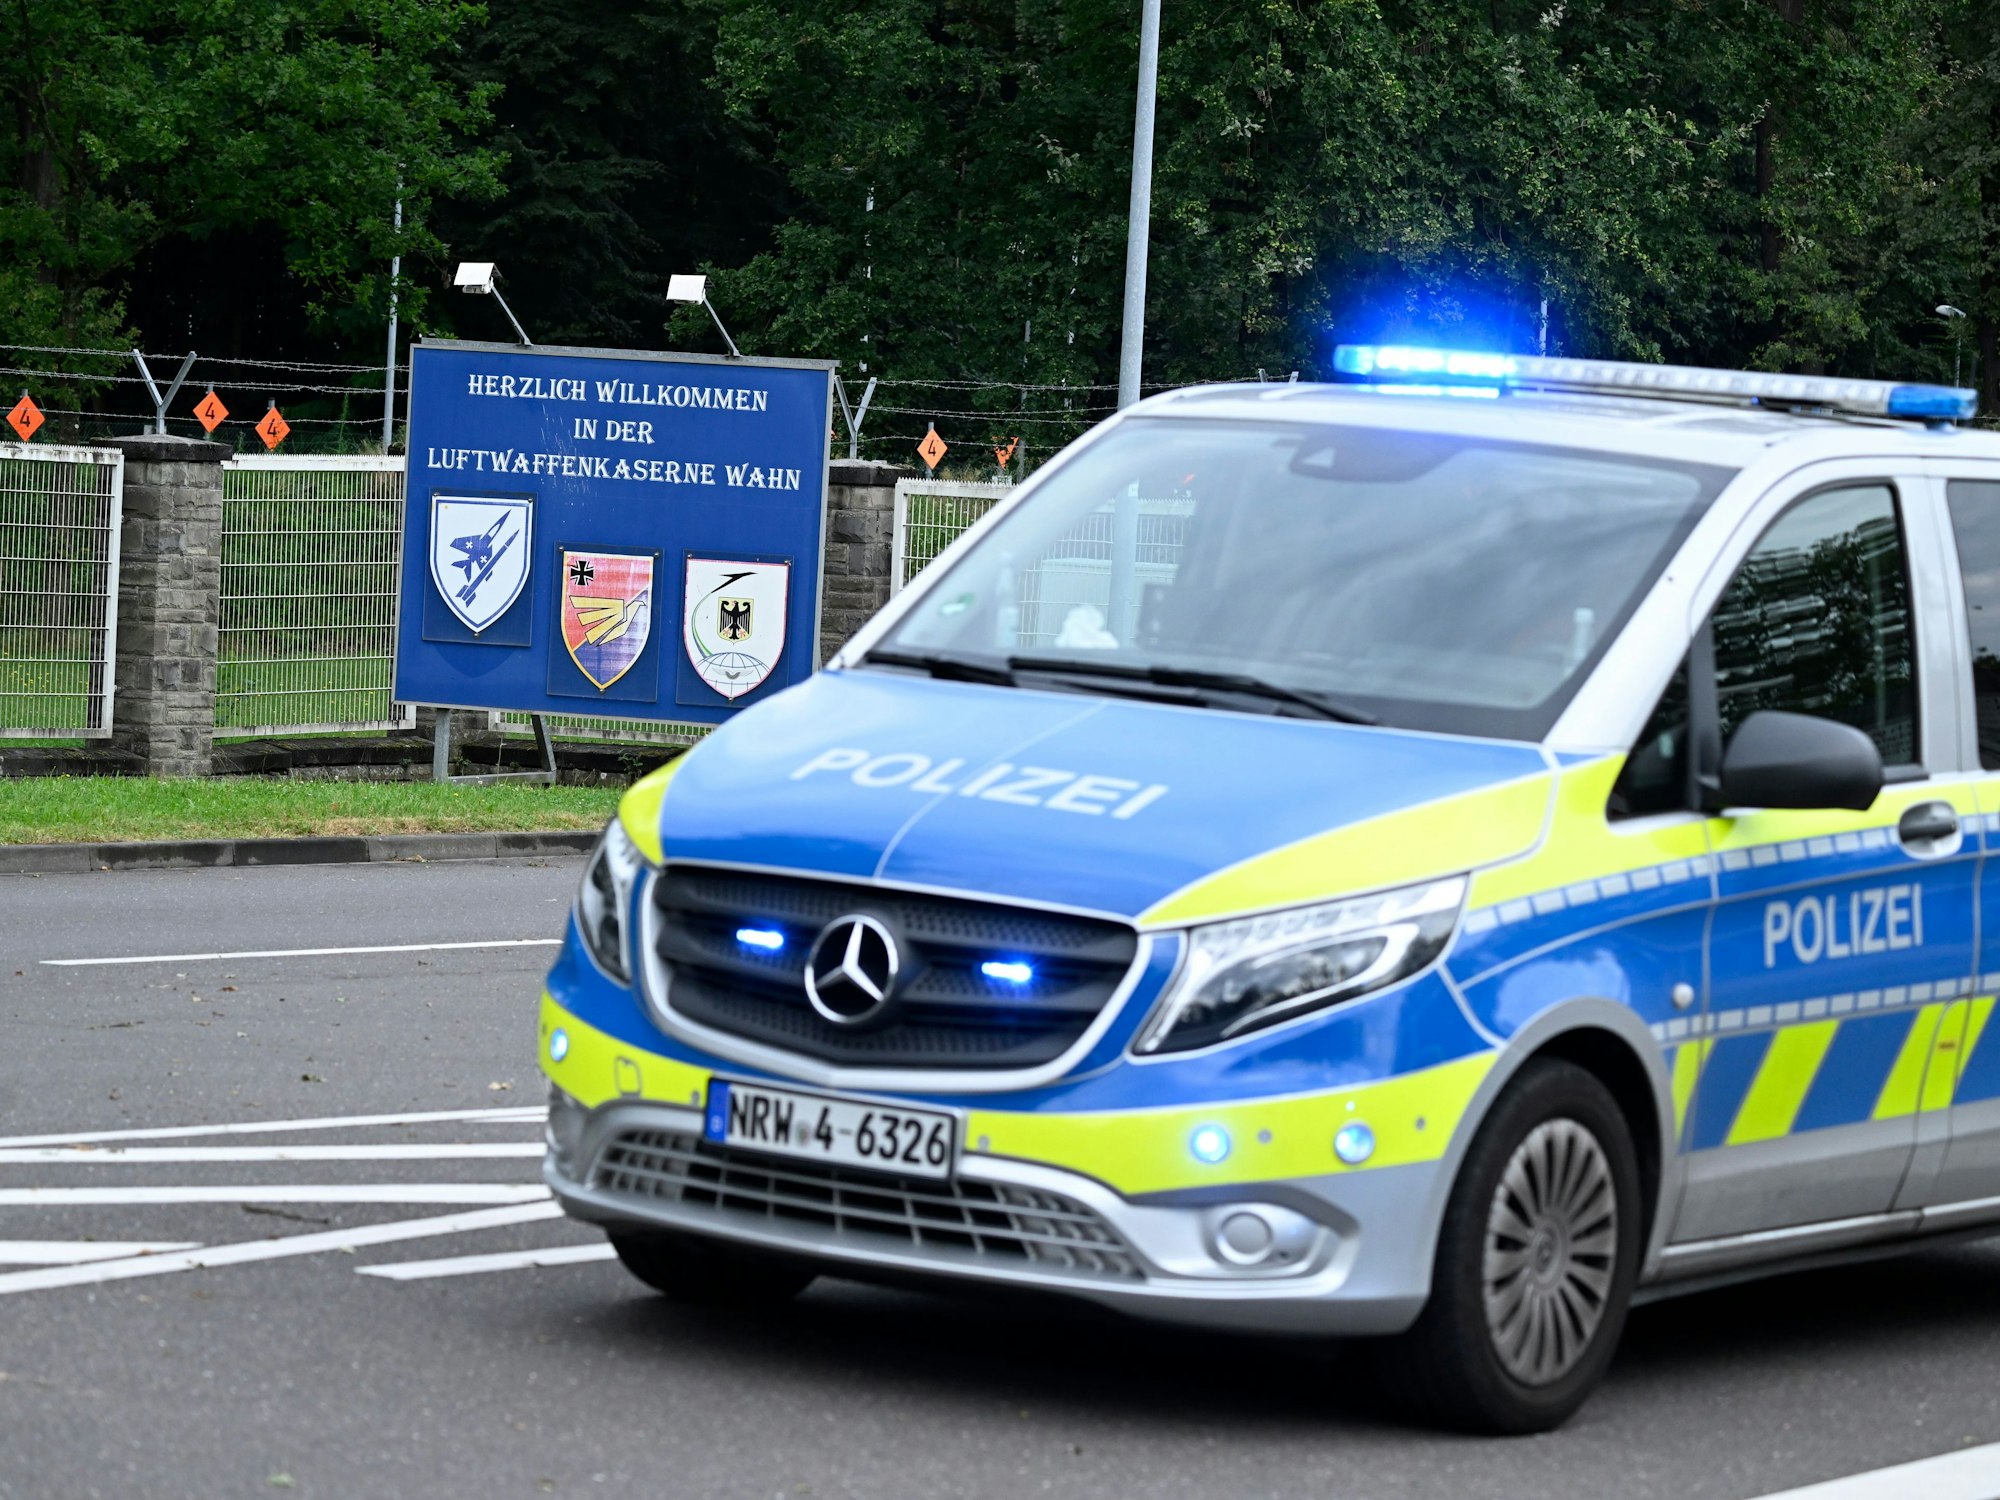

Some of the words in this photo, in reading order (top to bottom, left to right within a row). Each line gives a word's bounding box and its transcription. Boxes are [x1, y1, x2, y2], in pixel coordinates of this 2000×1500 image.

[468, 374, 587, 402] HERZLICH
[595, 378, 769, 412] WILLKOMMEN
[19, 406, 31, 428] 4
[205, 402, 215, 420] 4
[267, 418, 277, 438] 4
[573, 417, 598, 440] IN
[605, 420, 655, 444] DER
[928, 439, 937, 457] 4
[427, 447, 716, 486] LUFTWAFFENKASERNE
[725, 462, 802, 490] WAHN
[790, 747, 1169, 820] POLIZEI
[1764, 883, 1923, 968] POLIZEI
[728, 1093, 794, 1145] NRW
